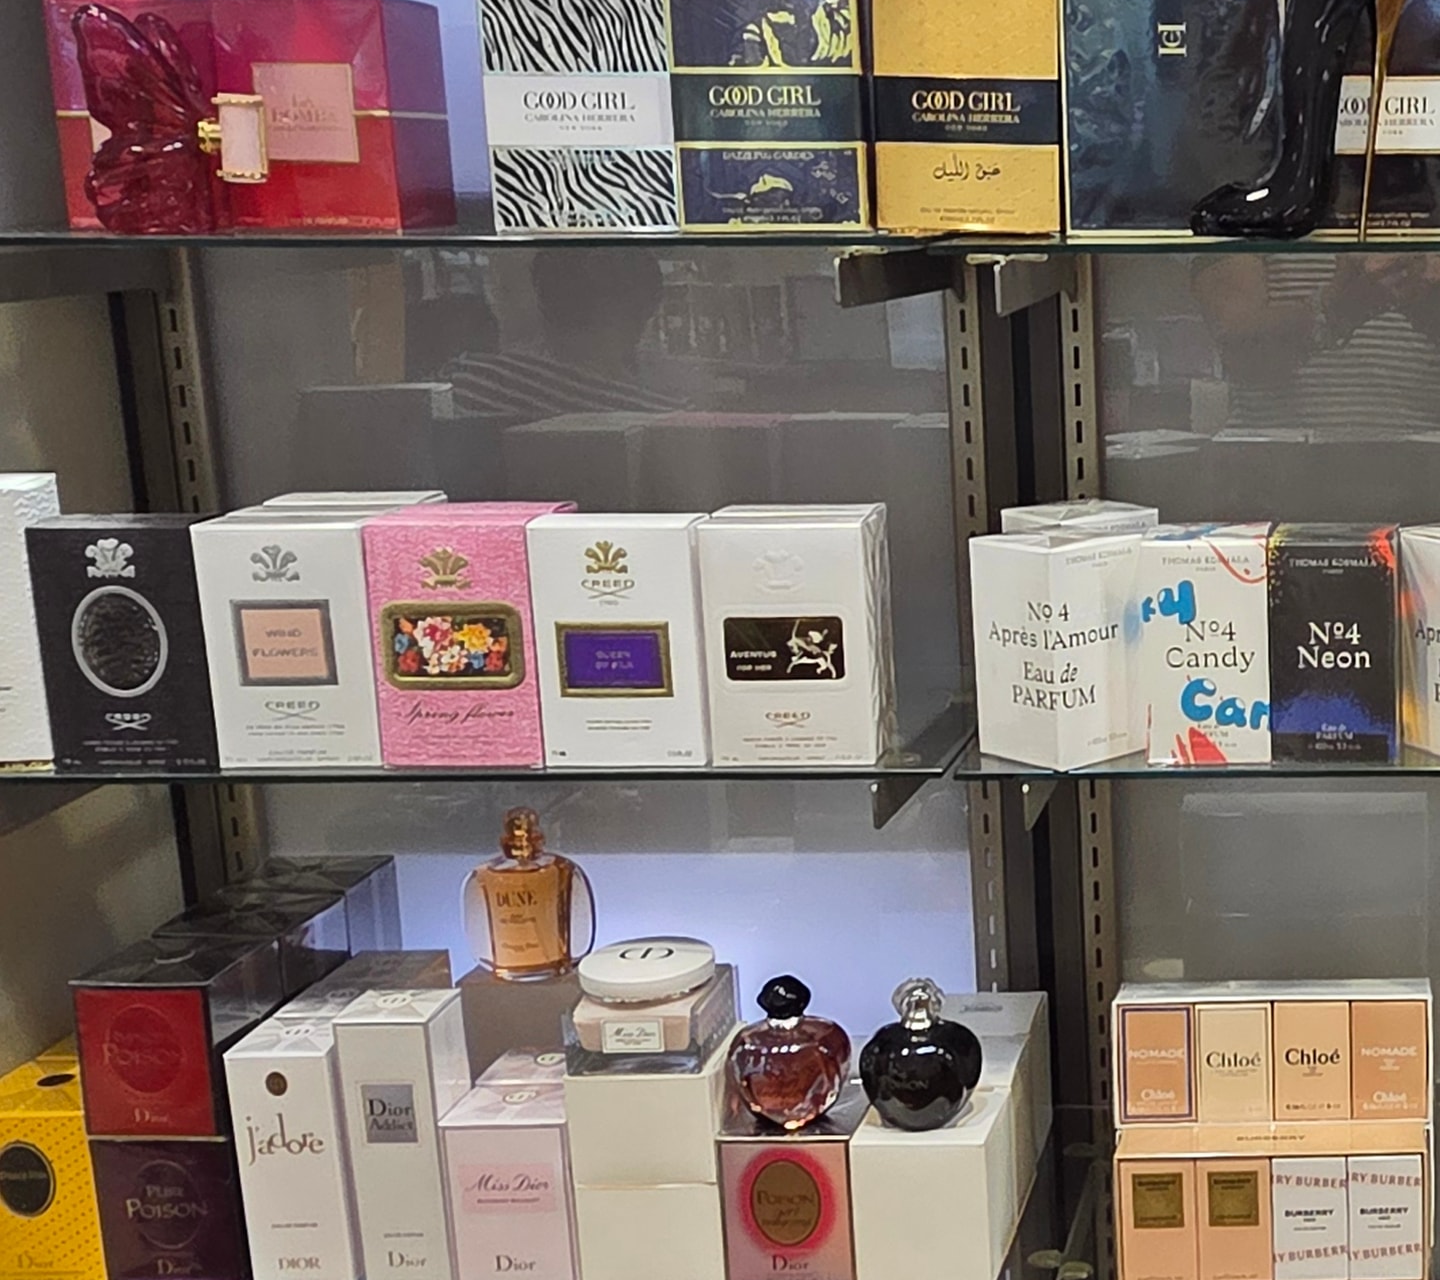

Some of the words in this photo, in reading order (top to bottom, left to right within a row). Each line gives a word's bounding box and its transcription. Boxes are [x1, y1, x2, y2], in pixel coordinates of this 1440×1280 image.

[523, 90, 577, 110] GOOD
[581, 91, 636, 110] GIRL
[708, 85, 763, 107] GOOD
[766, 85, 821, 106] GIRL
[911, 90, 966, 111] GOOD
[968, 91, 1022, 112] GIRL
[710, 108, 766, 119] CAROLINA
[767, 107, 821, 118] HERRERA
[1385, 96, 1436, 115] GIRL
[524, 113, 579, 123] CAROLINA
[581, 113, 636, 123] HERRERA
[911, 112, 966, 123] CAROLINA
[968, 113, 1021, 124] HERRERA
[580, 578, 635, 593] CREED
[1058, 602, 1071, 622] 4
[265, 628, 302, 638] WIND
[989, 622, 1038, 648] Après
[1043, 623, 1119, 651] l'Amour
[252, 647, 319, 658] FLOWERS
[730, 650, 777, 659] AVENTUS
[1166, 645, 1256, 673] Candy
[1297, 645, 1372, 669] Neon
[1023, 661, 1055, 685] Eau
[1060, 662, 1079, 685] de
[1012, 684, 1097, 711] PARFUM
[264, 700, 320, 715] CREED
[399, 700, 460, 724] Spring
[460, 701, 514, 726] flower
[496, 890, 538, 908] DUNE
[1128, 1049, 1187, 1059] NOMADE
[1205, 1051, 1262, 1069] Chloé
[1284, 1047, 1341, 1066] Chloé
[1360, 1046, 1418, 1057] NOMADE
[1140, 1087, 1176, 1100] Chloé
[1372, 1090, 1408, 1103] Chloé
[368, 1097, 413, 1118] Dior
[369, 1117, 415, 1132] Addict
[245, 1112, 325, 1166] j'adore
[464, 1173, 510, 1192] Miss
[512, 1172, 550, 1192] Dior
[1370, 1172, 1422, 1187] BURBER
[145, 1184, 186, 1198] PURE
[126, 1198, 208, 1220] POISON
[1284, 1208, 1334, 1218] BURBERRY
[1359, 1206, 1409, 1216] BURBERRY
[277, 1256, 321, 1270] DIOR
[386, 1250, 427, 1268] Dior
[494, 1254, 537, 1272] Dior
